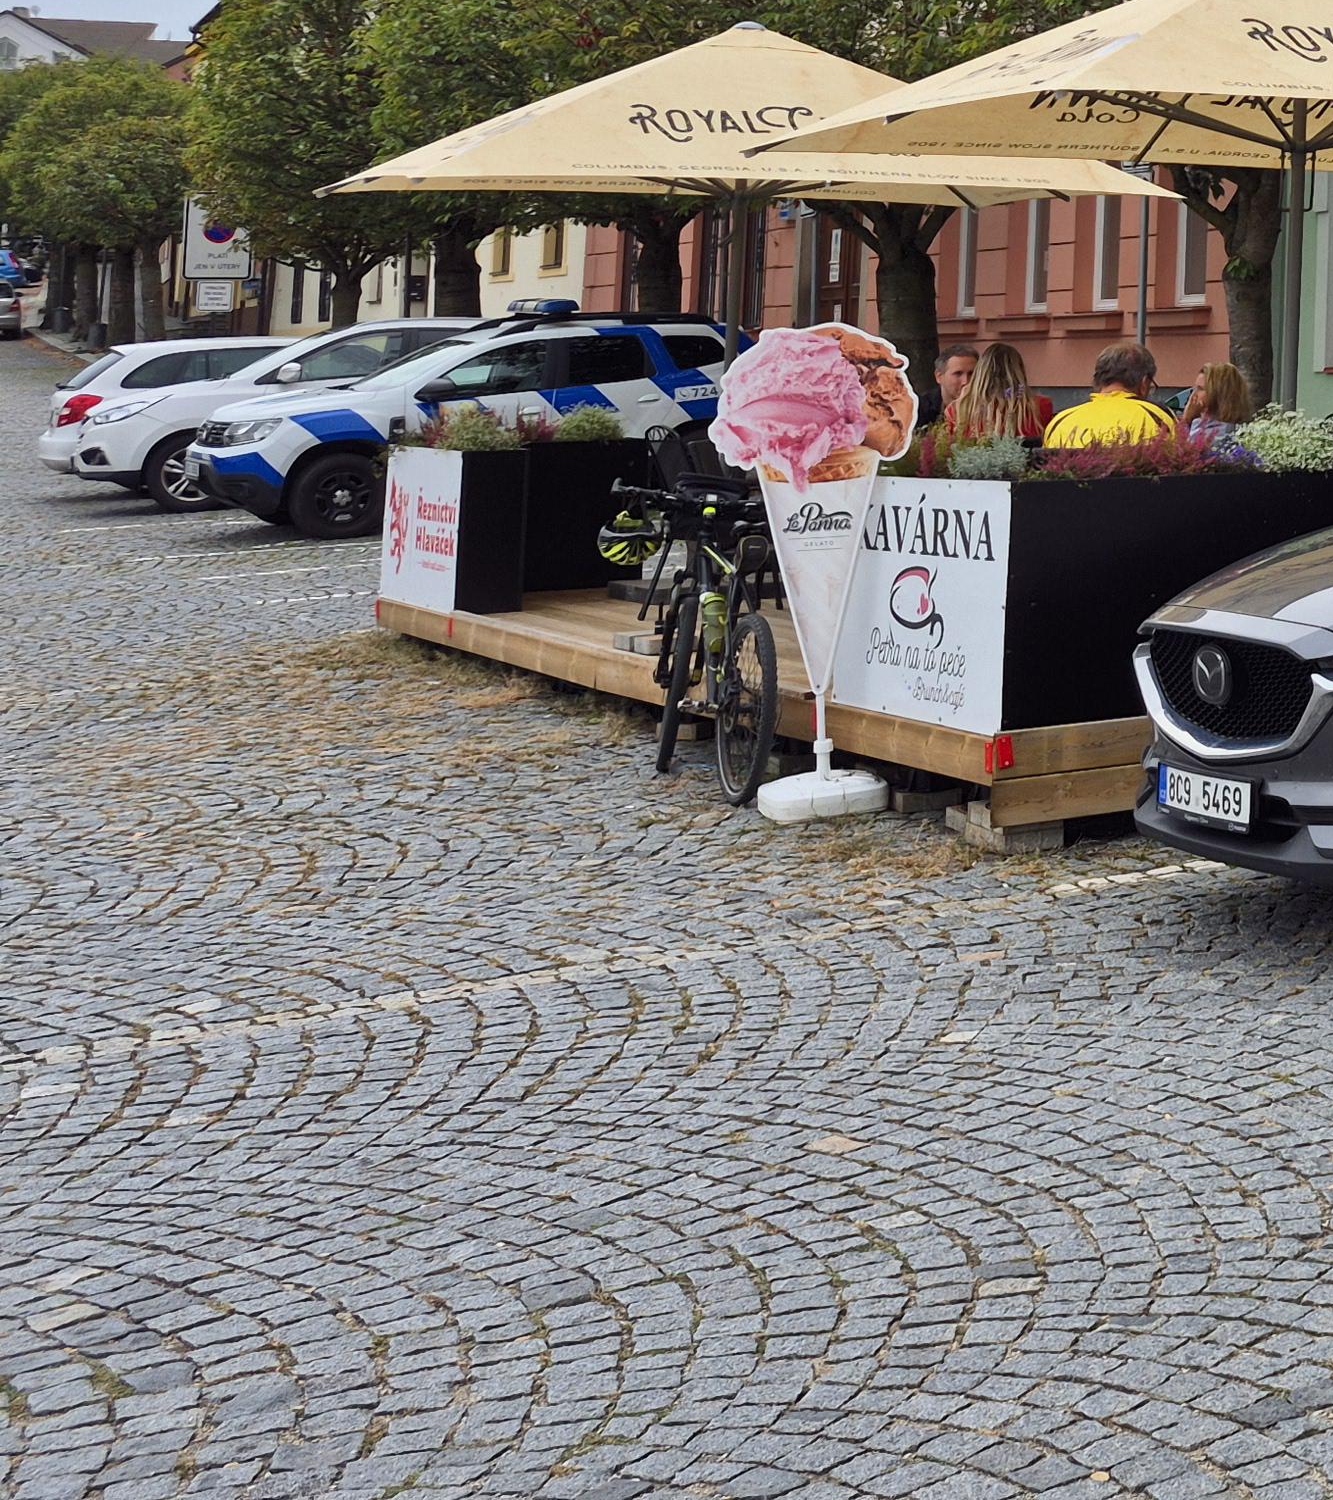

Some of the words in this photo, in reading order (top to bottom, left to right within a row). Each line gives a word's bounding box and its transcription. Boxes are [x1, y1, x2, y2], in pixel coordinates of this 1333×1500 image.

[628, 103, 771, 143] ROYAL
[691, 386, 719, 398] 724
[417, 486, 458, 525] Řeznictví
[415, 526, 455, 558] Hlaváček
[803, 540, 834, 548] GELATO
[866, 626, 901, 667] Petra
[904, 643, 921, 671] na
[923, 641, 936, 673] to
[937, 645, 967, 684] peče
[1168, 772, 1192, 806] 8C9
[1202, 780, 1243, 817] 5469
